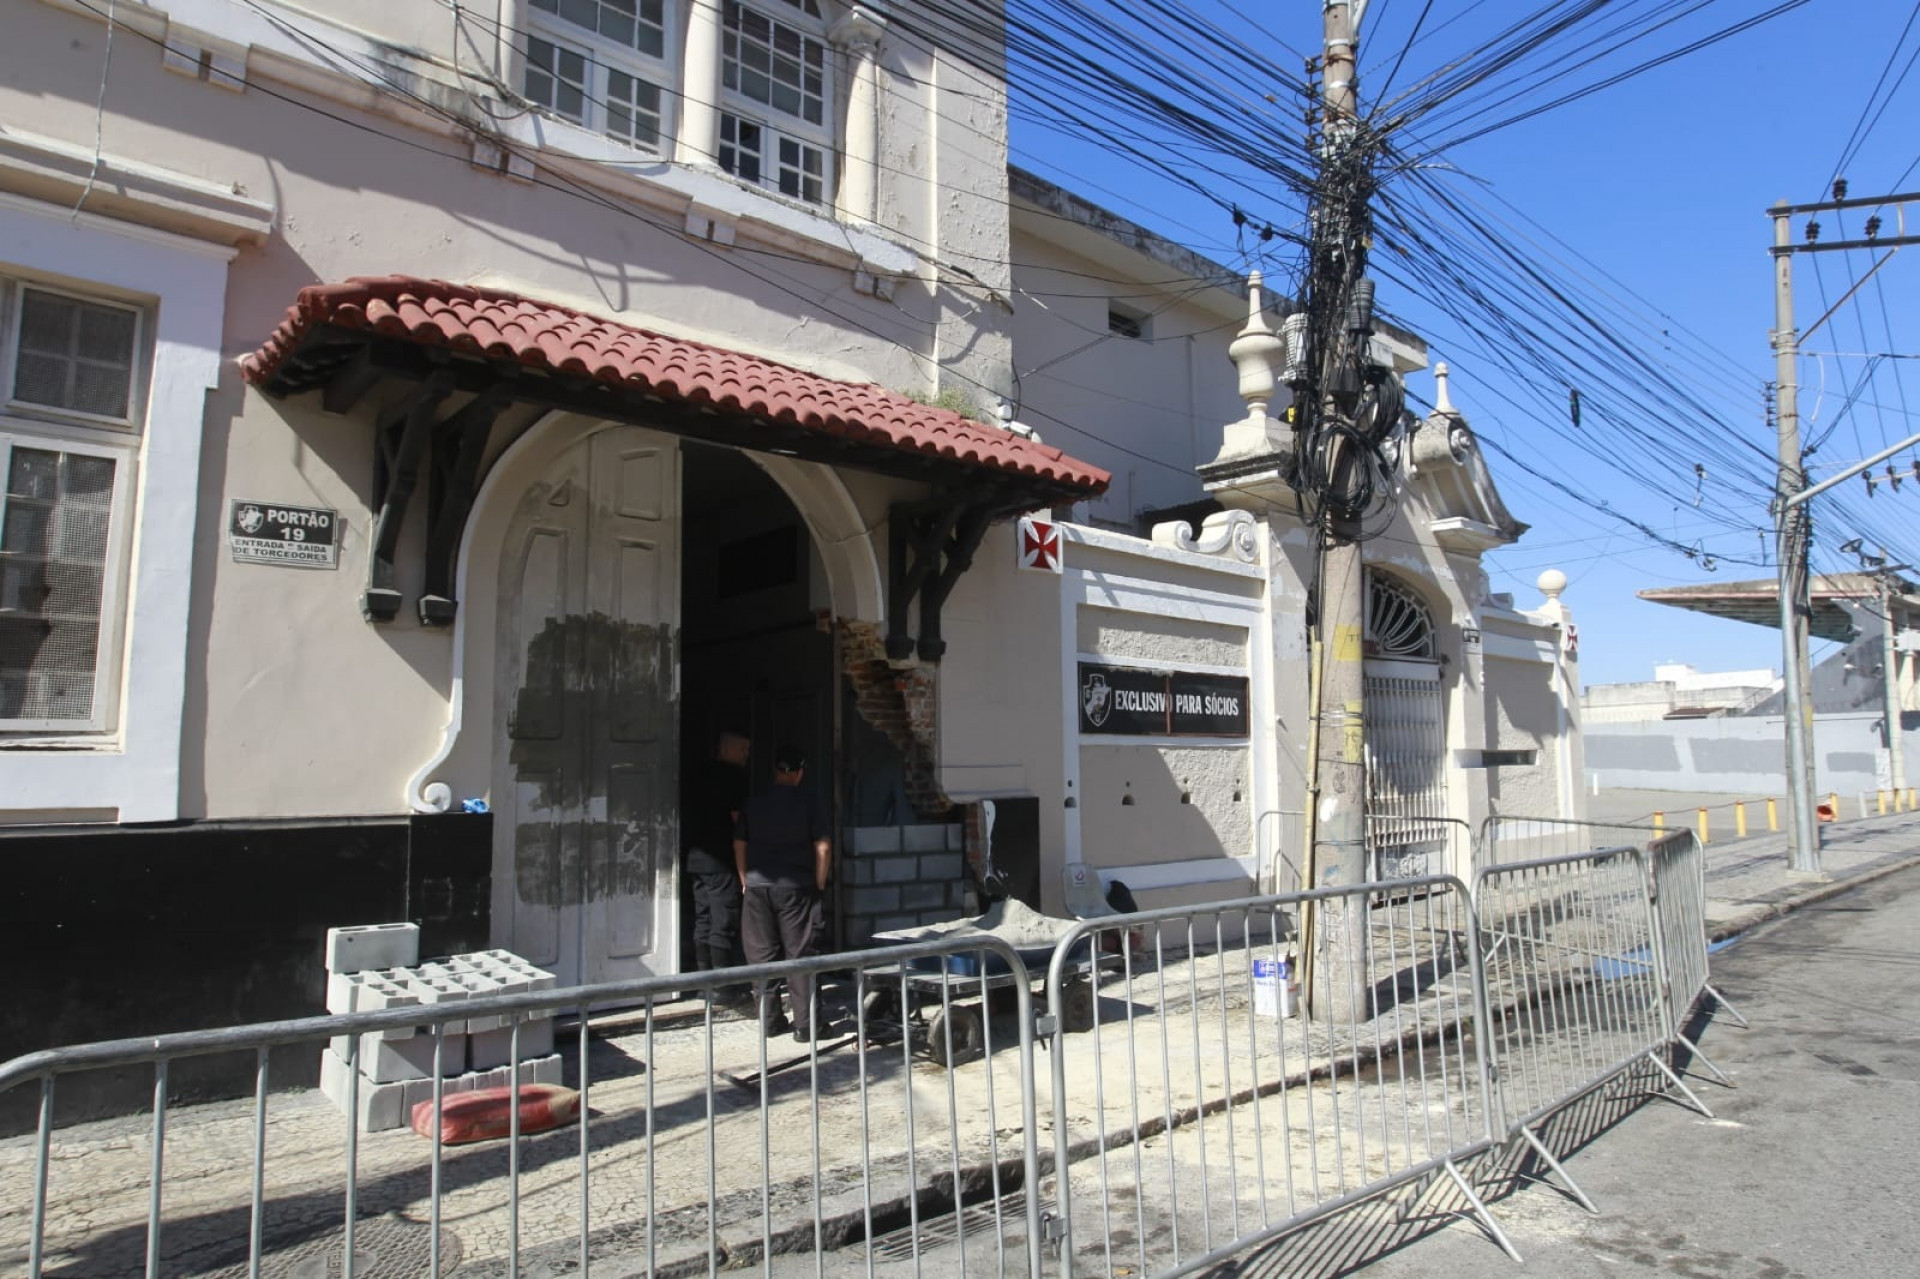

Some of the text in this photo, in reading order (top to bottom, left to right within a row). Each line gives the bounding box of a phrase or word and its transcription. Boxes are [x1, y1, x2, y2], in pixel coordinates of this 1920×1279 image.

[266, 509, 329, 528] PORTÃO
[280, 527, 306, 541] 19
[234, 538, 285, 549] ENTRADA
[234, 546, 328, 561] DE TORCEDORES
[1176, 693, 1203, 714] PARA
[1205, 691, 1239, 716] SÓCIOS
